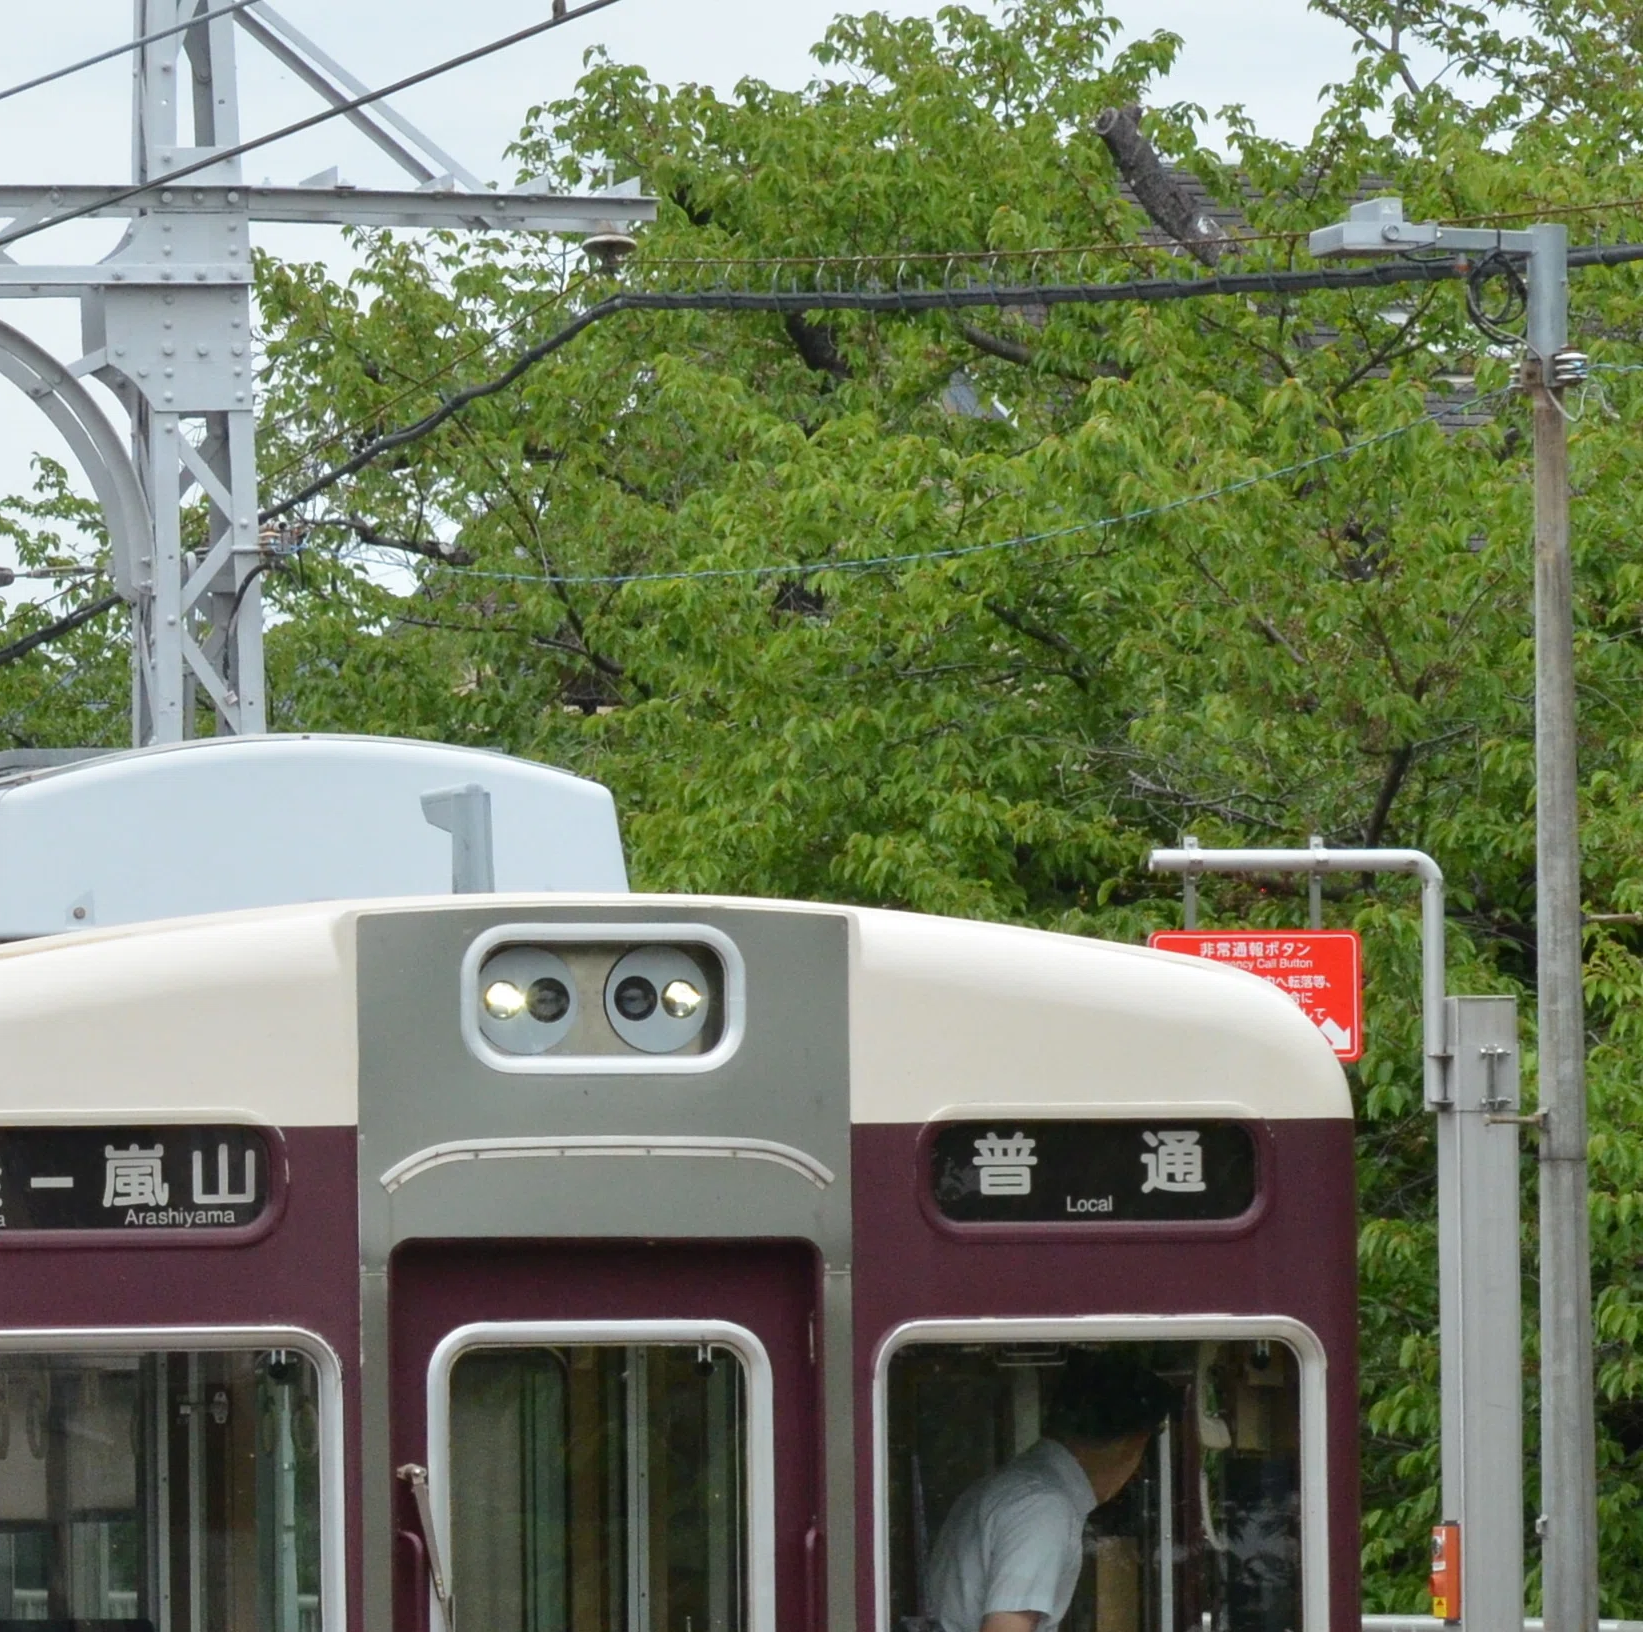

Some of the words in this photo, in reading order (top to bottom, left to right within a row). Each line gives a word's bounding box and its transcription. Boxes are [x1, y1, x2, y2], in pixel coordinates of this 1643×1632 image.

[1199, 941, 1311, 957] 非常通報ボタン
[1256, 958, 1277, 969] Call
[1279, 959, 1313, 969] Button
[1066, 1195, 1113, 1213] Local
[124, 1208, 236, 1229] Arashiyama
